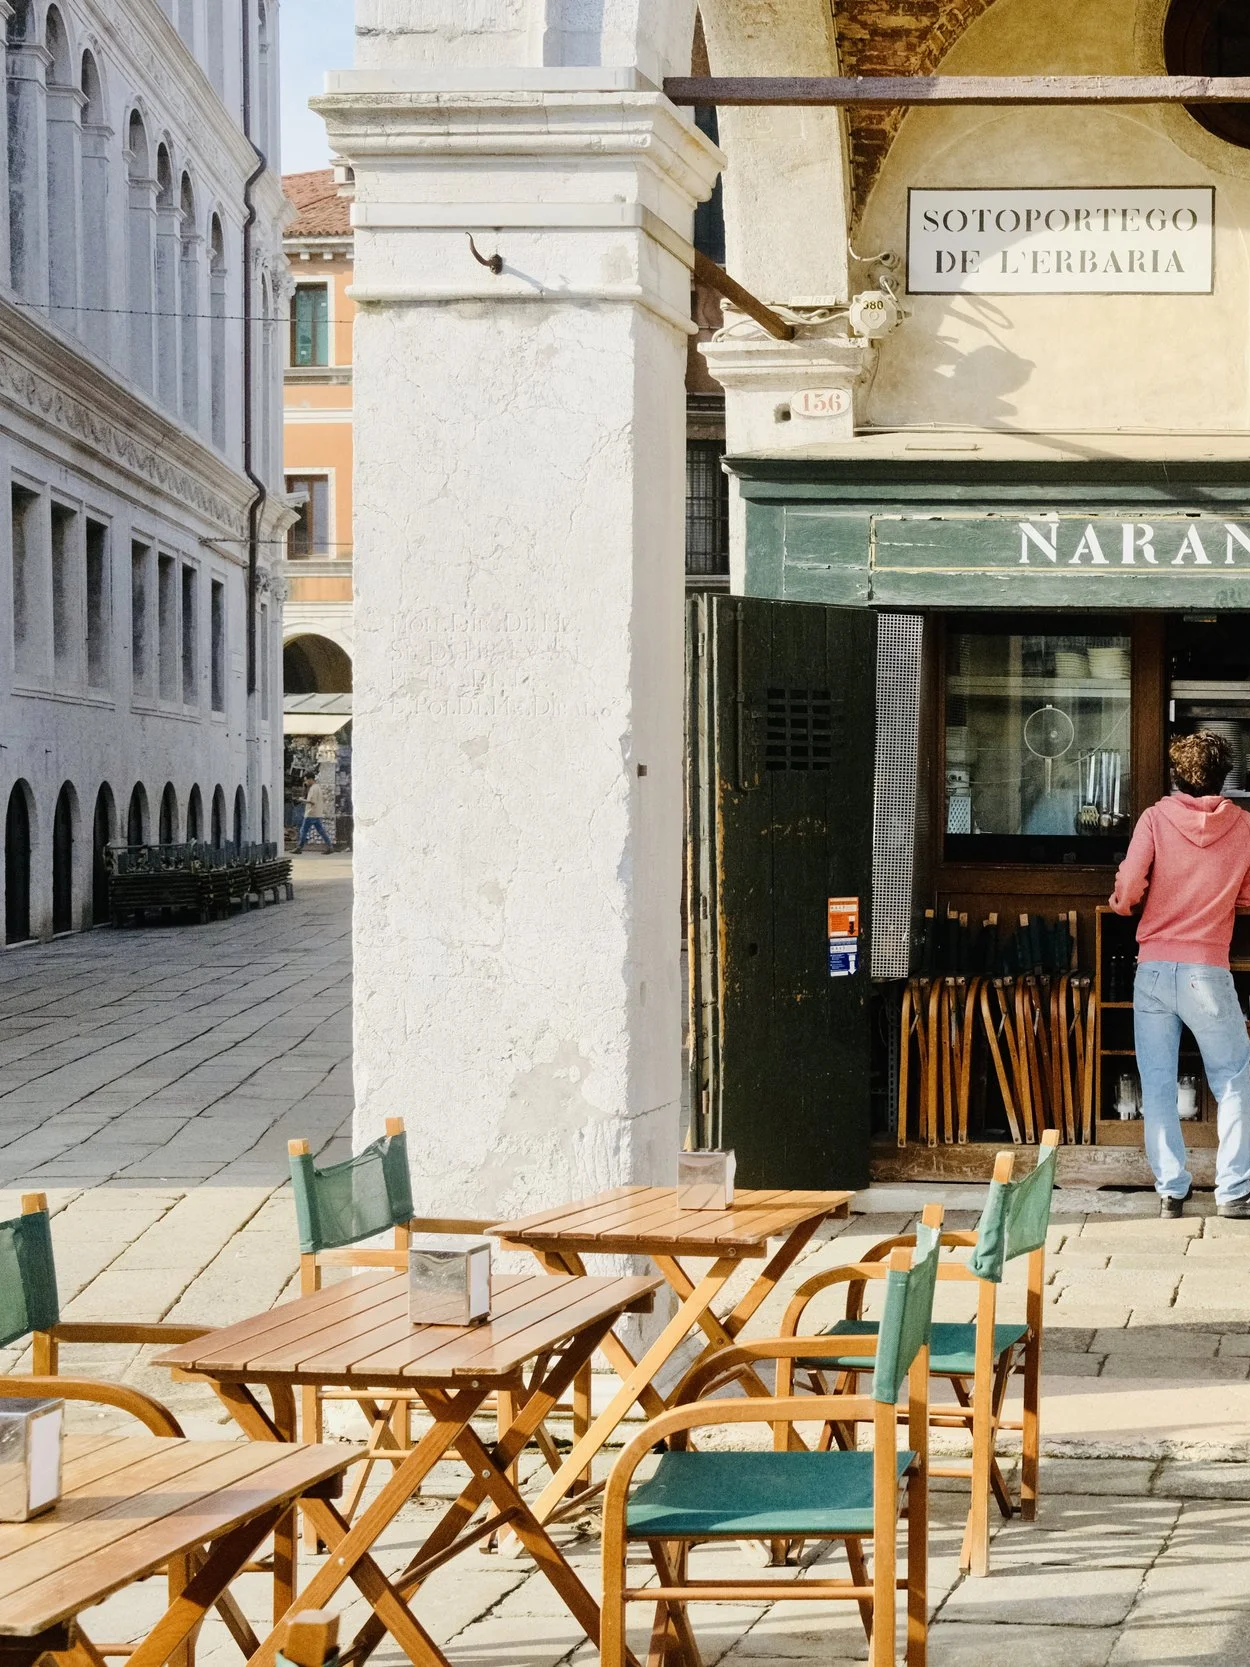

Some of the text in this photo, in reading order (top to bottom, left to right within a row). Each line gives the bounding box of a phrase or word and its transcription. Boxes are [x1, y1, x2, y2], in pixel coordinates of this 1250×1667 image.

[922, 208, 1198, 233] SOTOPORTEGO
[935, 249, 1185, 274] DE L'ERBARIA
[803, 392, 842, 412] 156
